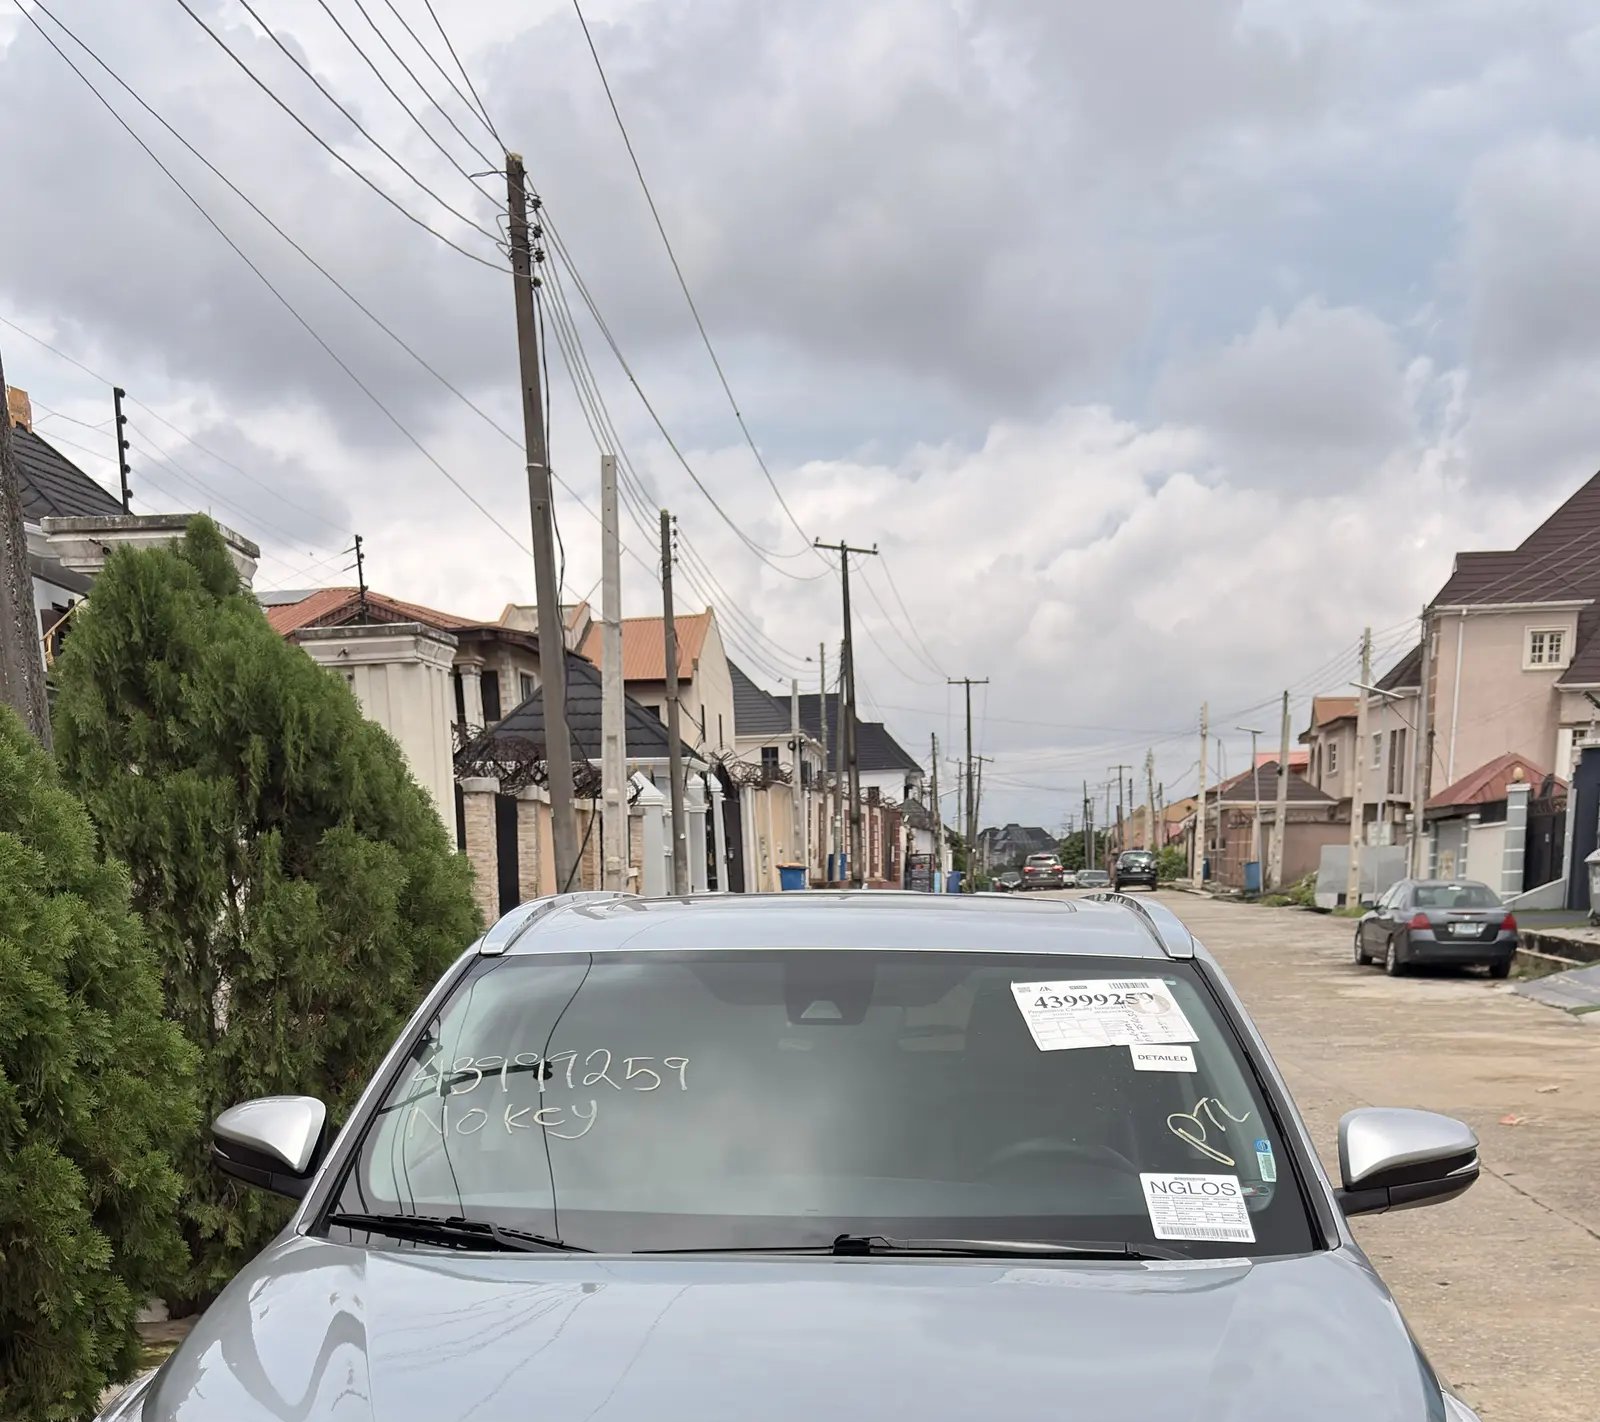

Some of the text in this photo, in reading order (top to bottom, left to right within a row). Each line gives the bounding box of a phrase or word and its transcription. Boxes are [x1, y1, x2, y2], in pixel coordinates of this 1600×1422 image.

[1034, 992, 1154, 1009] 43999259
[1137, 1054, 1188, 1062] DETAILED
[411, 1048, 690, 1099] 43999259
[1149, 1180, 1237, 1196] NGLOS
